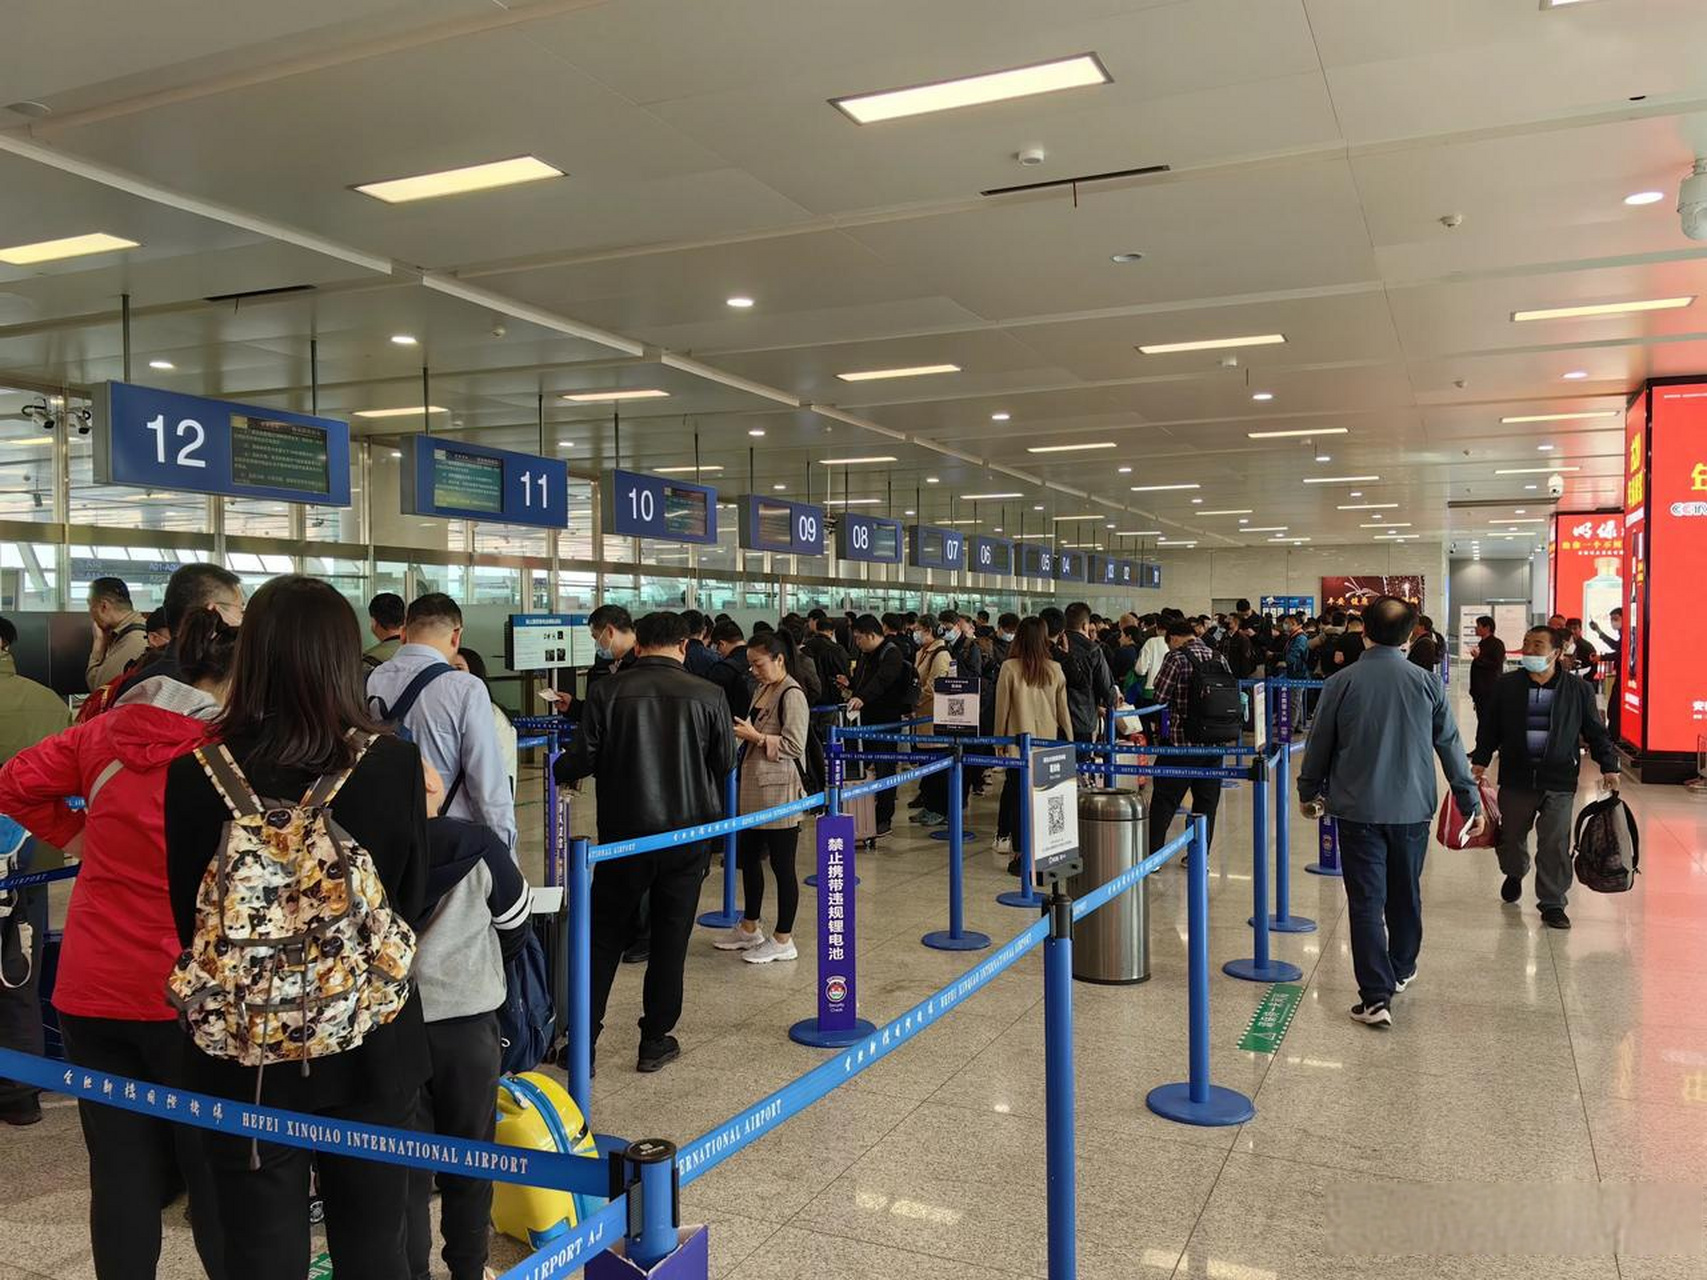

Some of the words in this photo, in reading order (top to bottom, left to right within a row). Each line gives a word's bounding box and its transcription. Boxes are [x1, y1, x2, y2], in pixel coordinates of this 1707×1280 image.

[147, 414, 207, 468] 12
[520, 471, 547, 509] 11
[628, 487, 655, 522] 10
[798, 515, 817, 543] 09
[852, 525, 869, 550] 08
[946, 540, 959, 560] 07
[980, 545, 992, 564] 06
[827, 838, 844, 961] 禁止携带违规锂电池
[744, 1098, 782, 1135] AIRPORT
[242, 1112, 279, 1133] HEFEI
[287, 1120, 341, 1144] XINQIAO
[347, 1130, 459, 1164] INTERNATIONAL
[464, 1150, 529, 1175] AIRPORT
[587, 1222, 604, 1248] AJ
